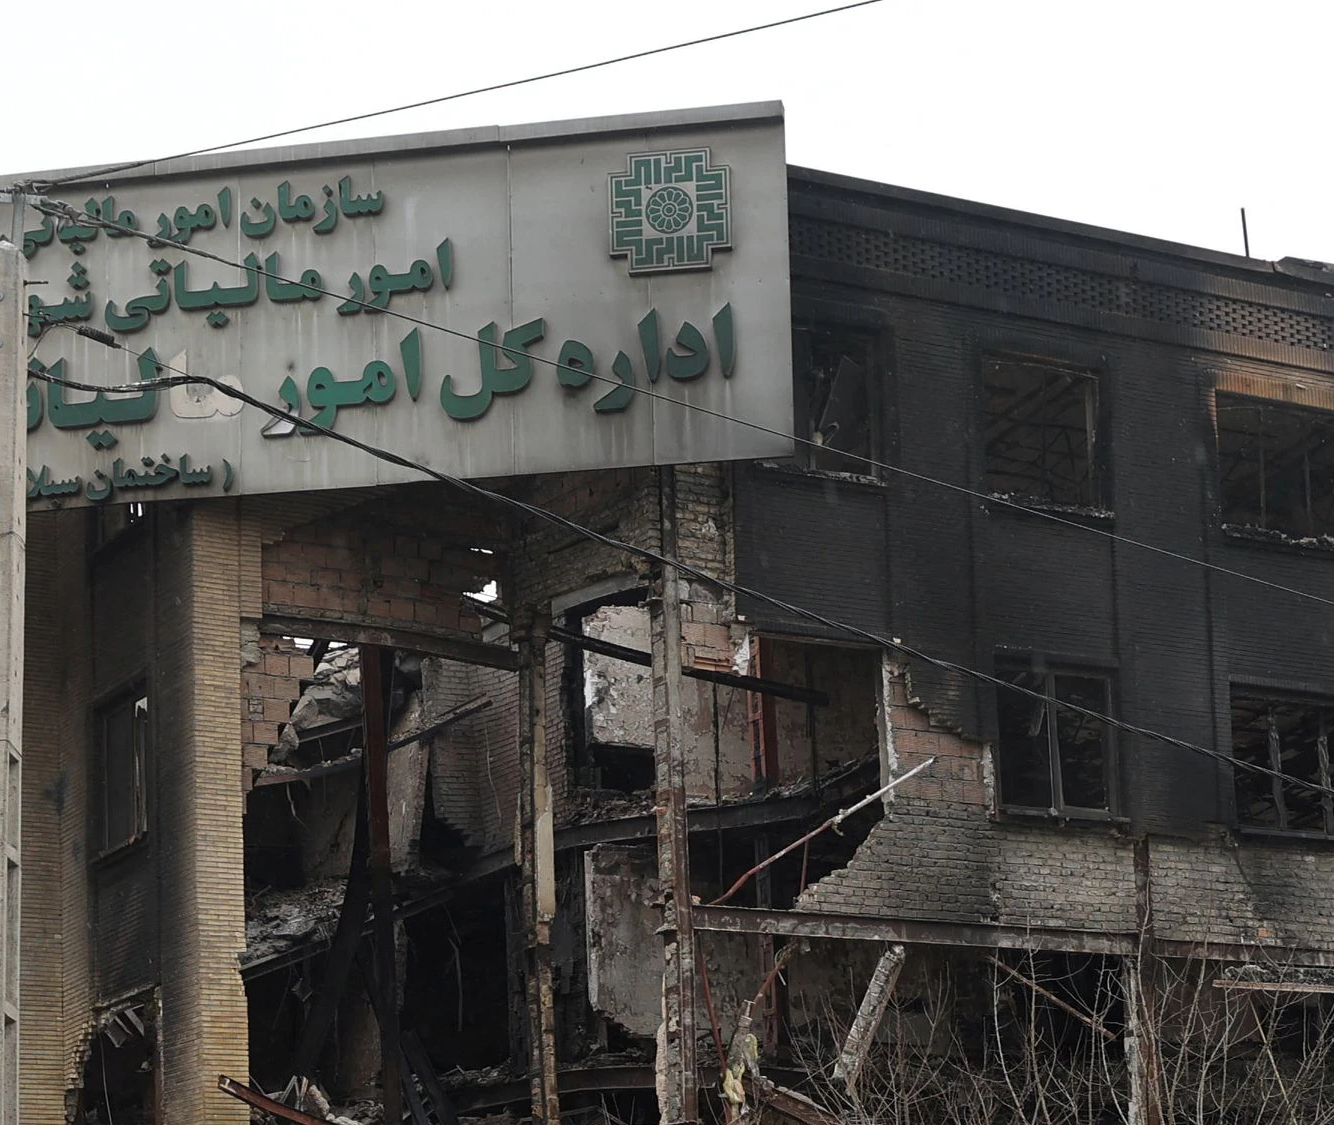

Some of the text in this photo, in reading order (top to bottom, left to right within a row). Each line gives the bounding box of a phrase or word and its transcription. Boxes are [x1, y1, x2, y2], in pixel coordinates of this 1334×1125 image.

[146, 186, 231, 248] امور
[240, 175, 384, 239] سازمان
[104, 251, 323, 333] مالیاتی
[336, 237, 454, 316] امور
[259, 327, 422, 441] امور
[439, 317, 547, 422] کل
[557, 302, 736, 414] اداره
[27, 464, 83, 510] سبلا
